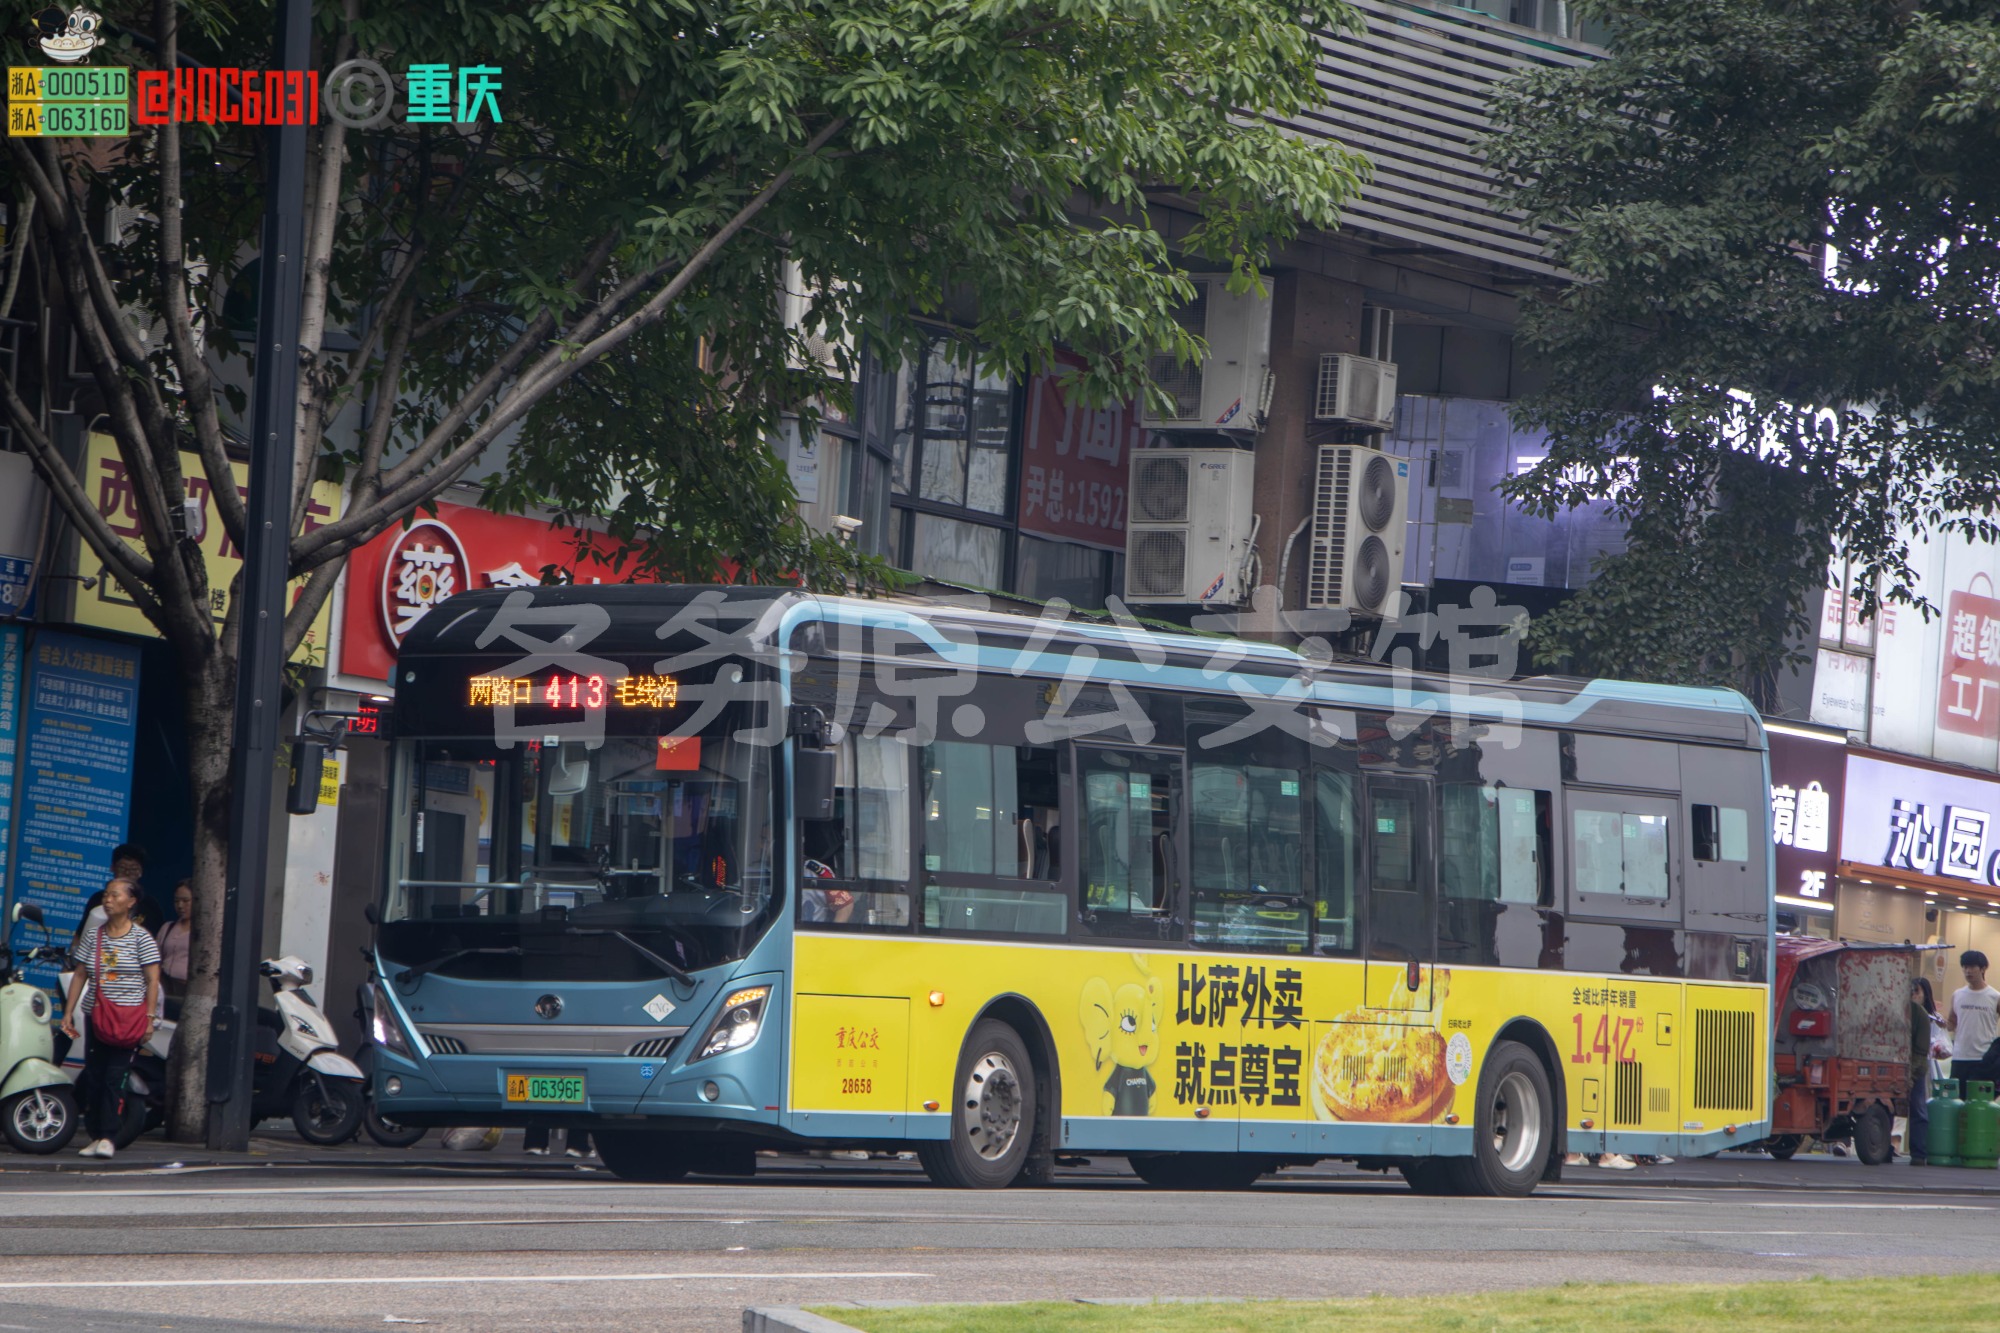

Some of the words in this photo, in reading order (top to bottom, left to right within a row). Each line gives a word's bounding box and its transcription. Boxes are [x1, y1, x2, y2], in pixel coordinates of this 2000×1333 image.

[1826, 589, 1897, 637] 品质后
[1952, 609, 2000, 667] 超级
[470, 676, 531, 706] 两路口
[546, 675, 603, 708] 413
[615, 676, 678, 708] 毛线沟
[1947, 673, 1999, 722] 工厂
[1886, 799, 1991, 881] 沁园
[1800, 870, 1827, 897] 2F
[648, 1002, 670, 1014] CNG
[1176, 962, 1303, 1030] 比萨外卖
[835, 1026, 880, 1050] 重庆公交
[842, 1077, 872, 1094] 28658
[1174, 1041, 1302, 1107] 就点尊宝
